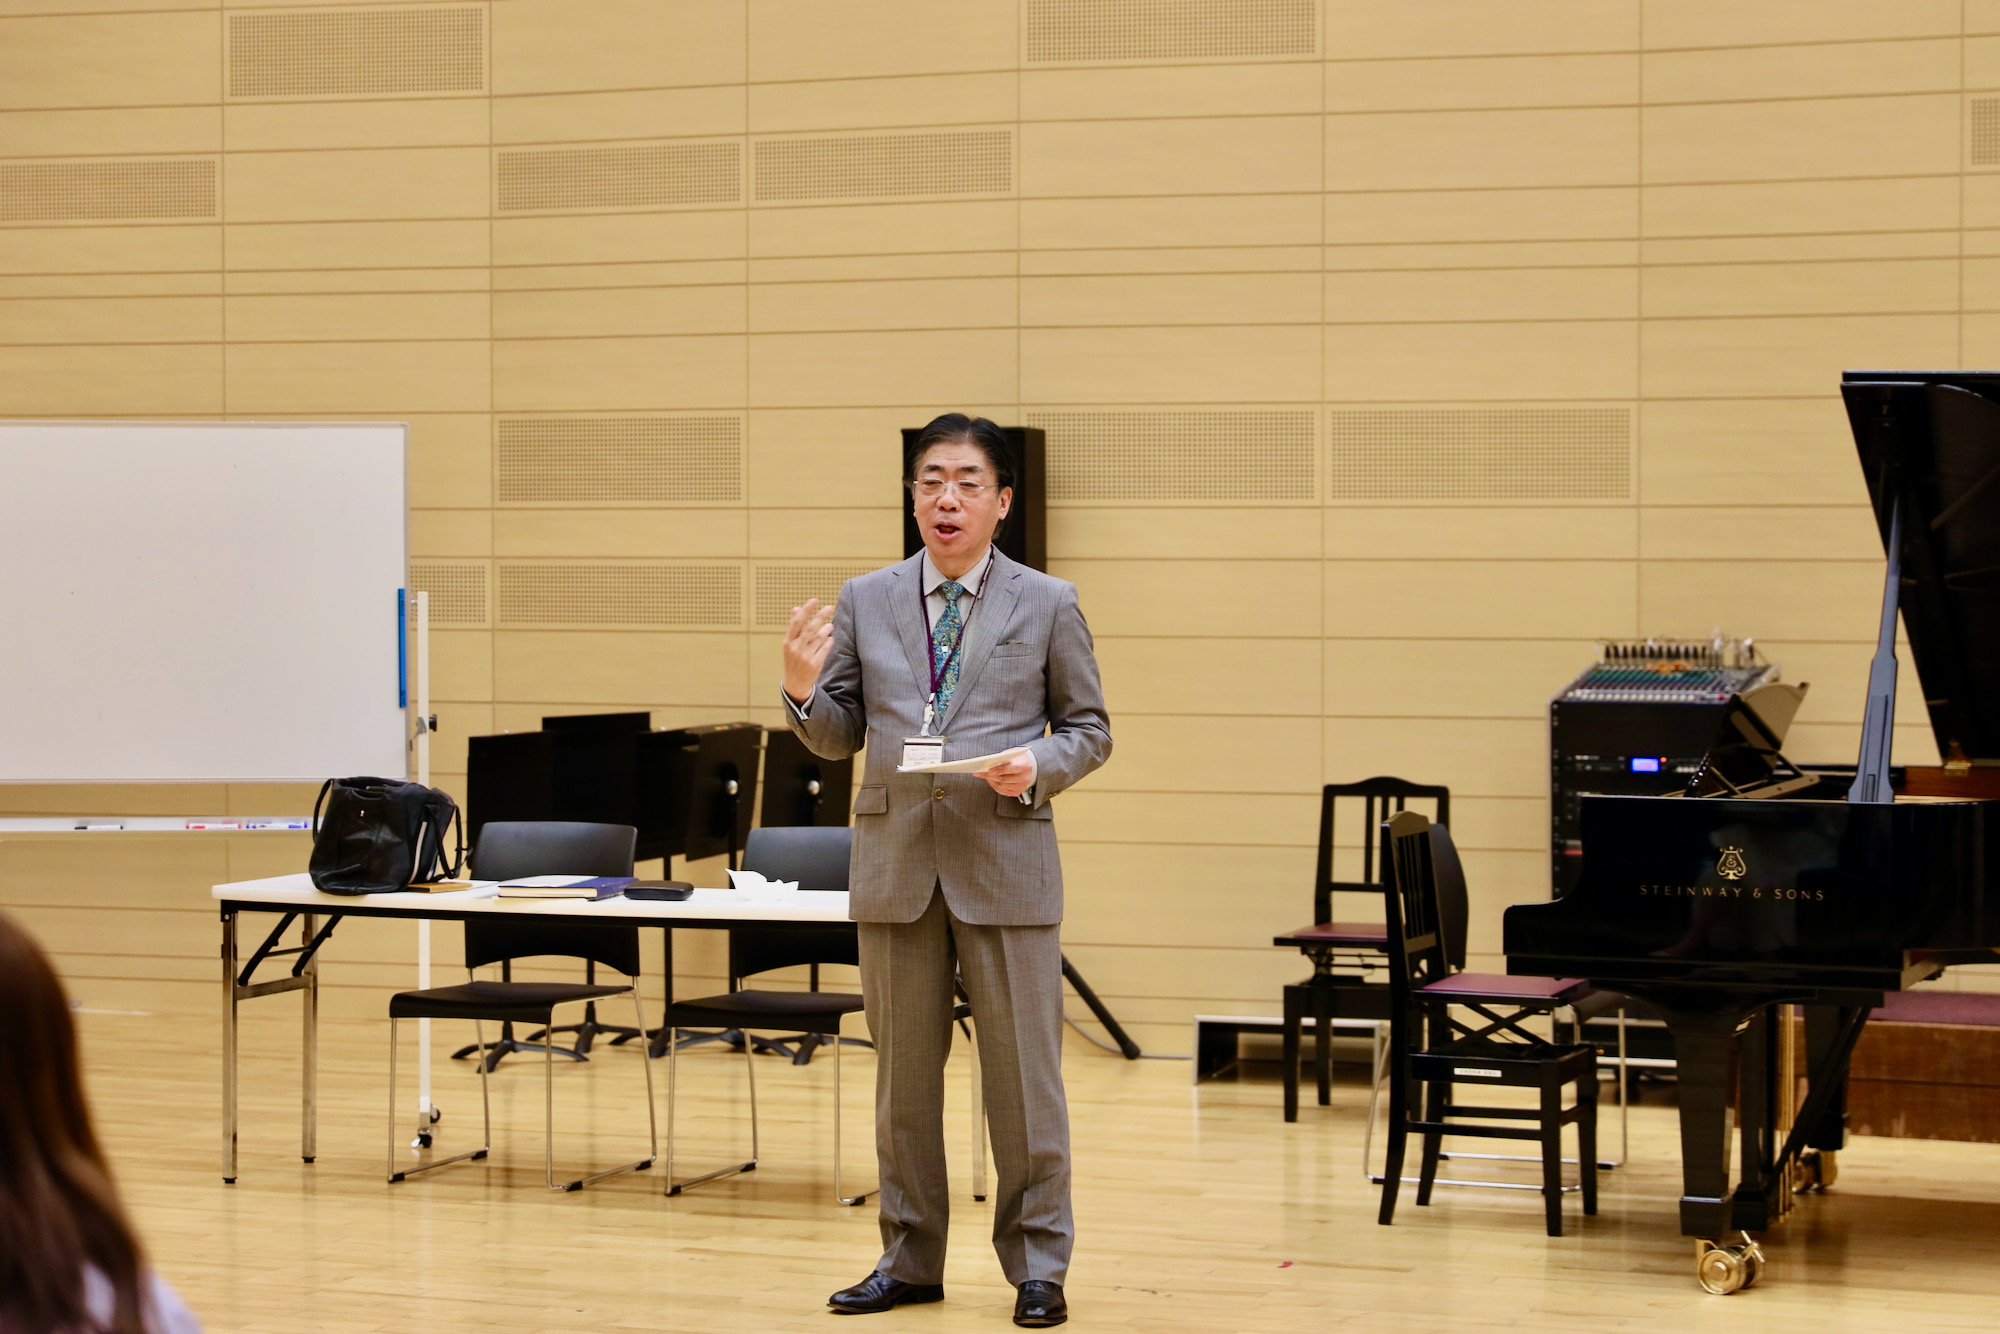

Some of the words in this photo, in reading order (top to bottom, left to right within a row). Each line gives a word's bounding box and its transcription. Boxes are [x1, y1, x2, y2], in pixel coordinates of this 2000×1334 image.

[1639, 884, 1742, 898] STEINWAY
[1752, 888, 1762, 899] &
[1774, 888, 1825, 901] SONS
